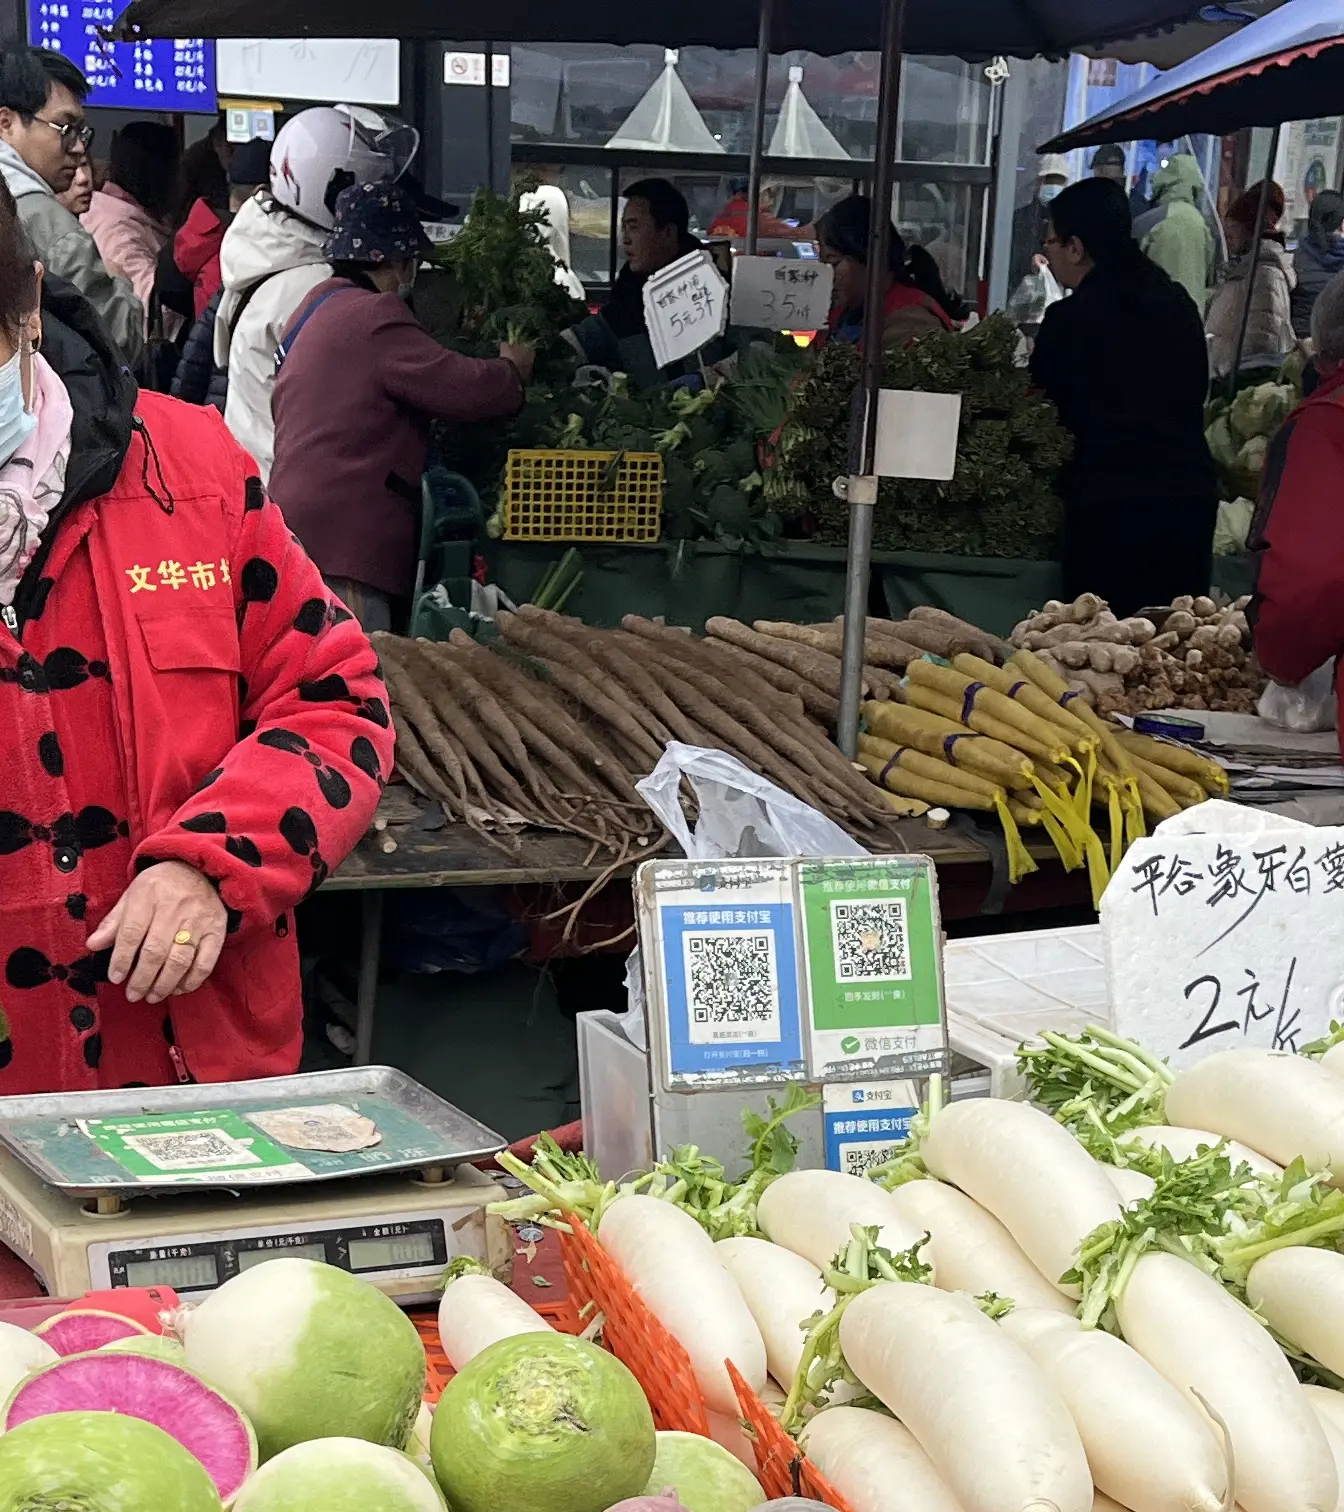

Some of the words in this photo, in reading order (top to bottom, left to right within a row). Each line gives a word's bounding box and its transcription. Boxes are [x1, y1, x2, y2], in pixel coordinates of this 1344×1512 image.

[683, 909, 772, 926] 推荐使用支付宝
[864, 1035, 917, 1051] 微信支付
[865, 1089, 893, 1101] 支付宝
[832, 1117, 913, 1135] 推荐使用支付宝
